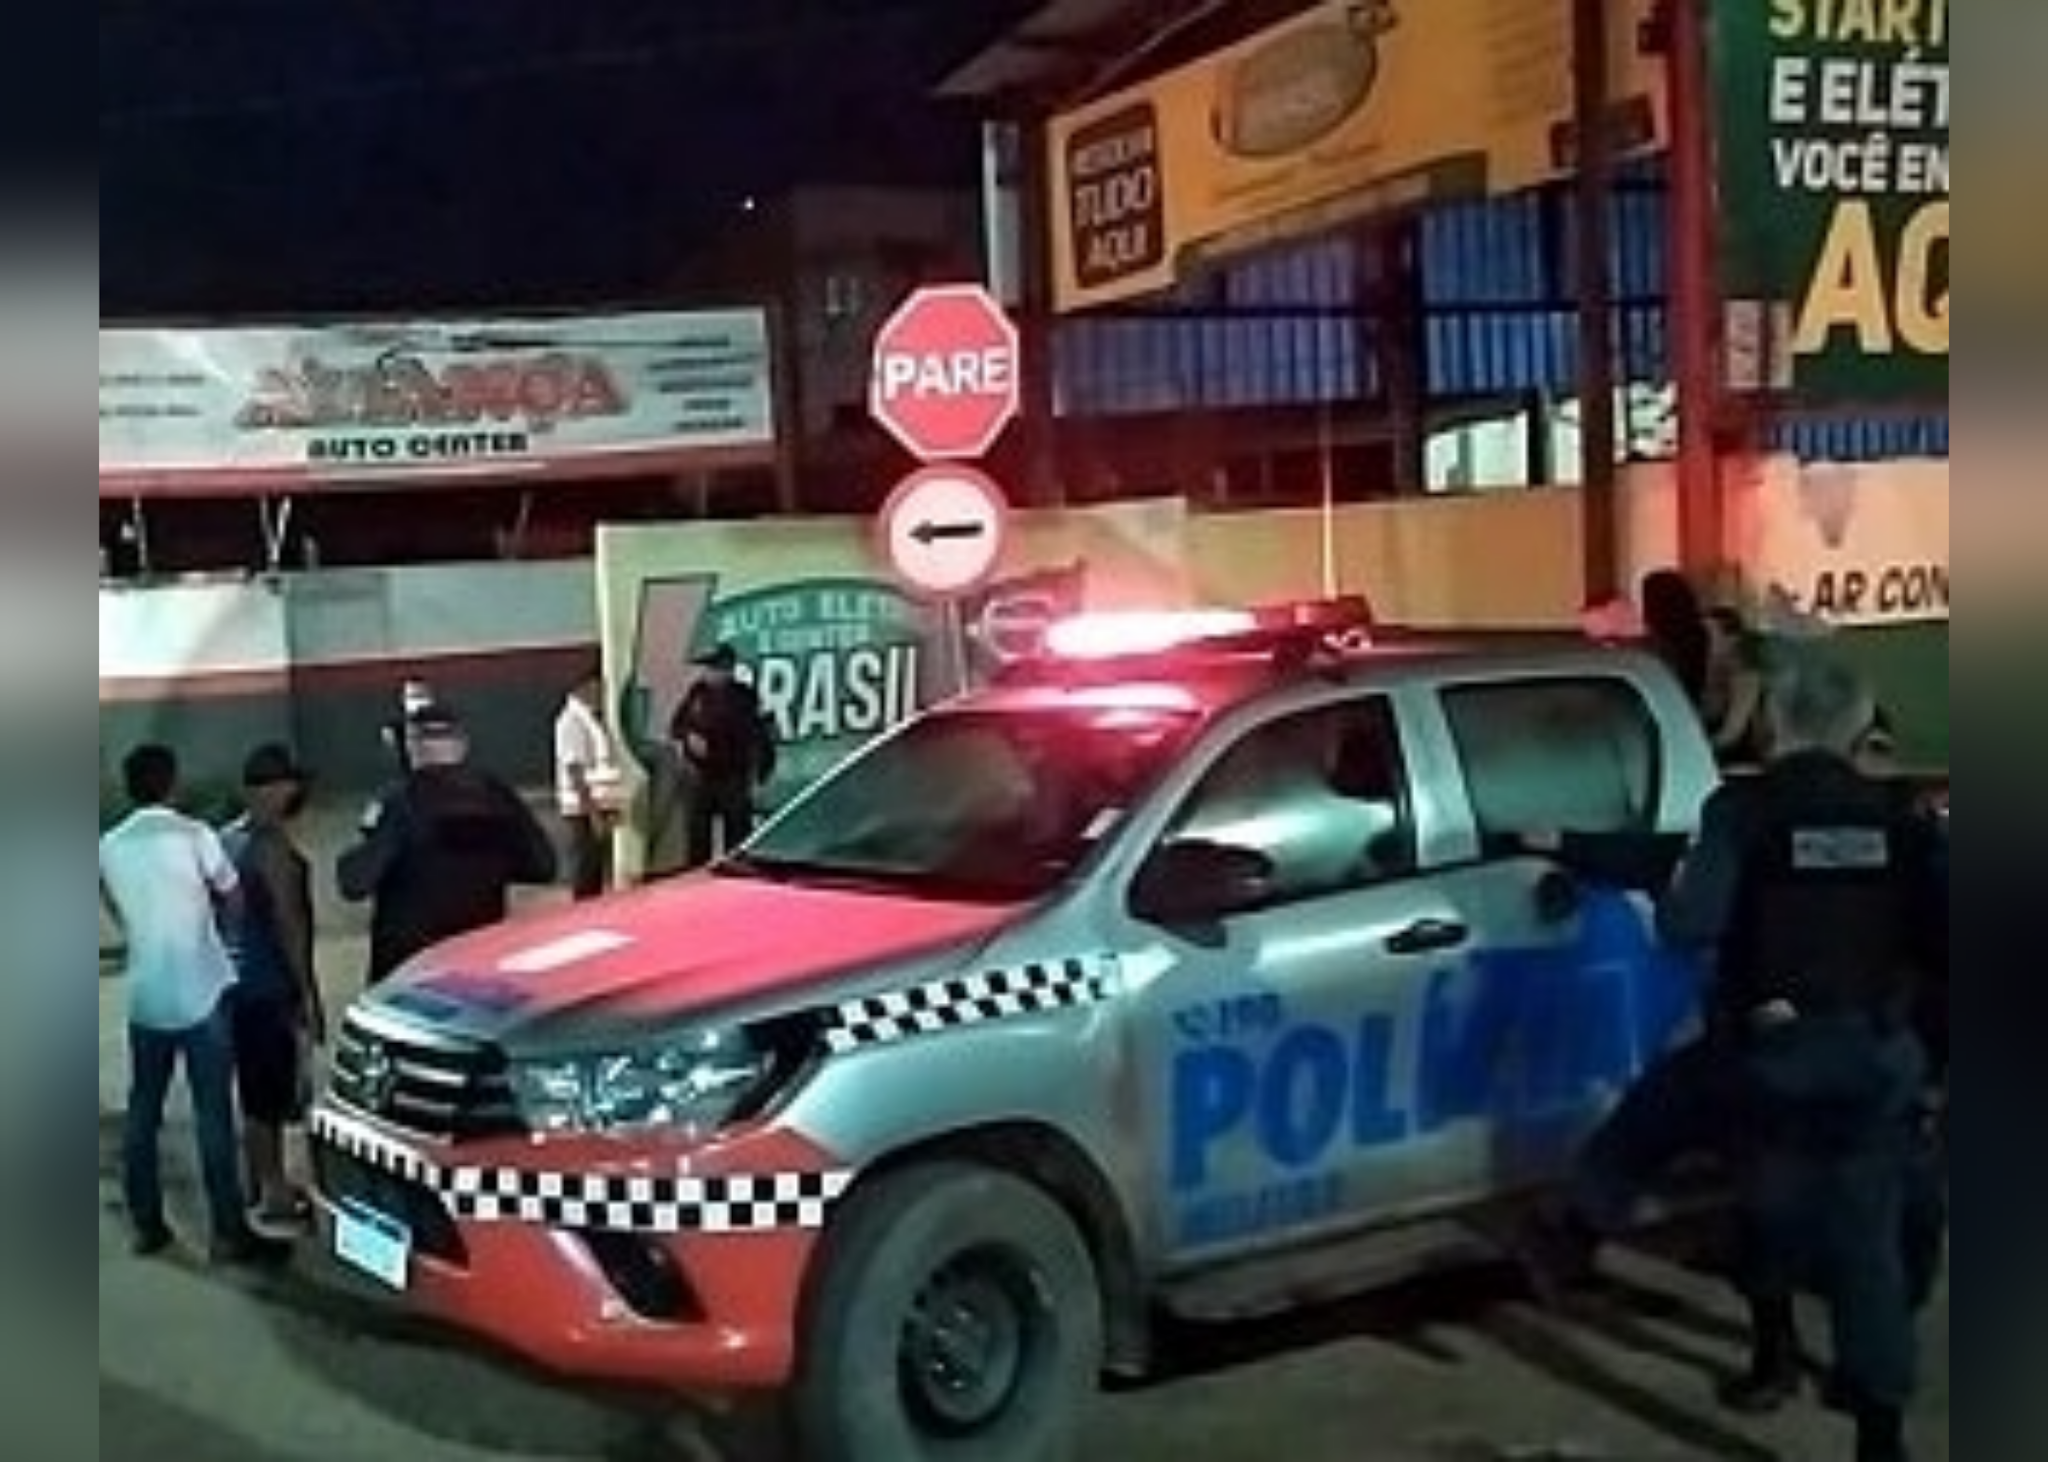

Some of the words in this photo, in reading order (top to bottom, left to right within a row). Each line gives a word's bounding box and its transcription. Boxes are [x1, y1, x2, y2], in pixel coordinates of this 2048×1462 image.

[1770, 57, 1808, 122] E
[1771, 132, 1889, 191] VOCÊ
[883, 346, 1010, 401] PARE
[307, 436, 397, 459] AUTO
[406, 432, 528, 459] CENTER
[735, 645, 917, 740] RASIL
